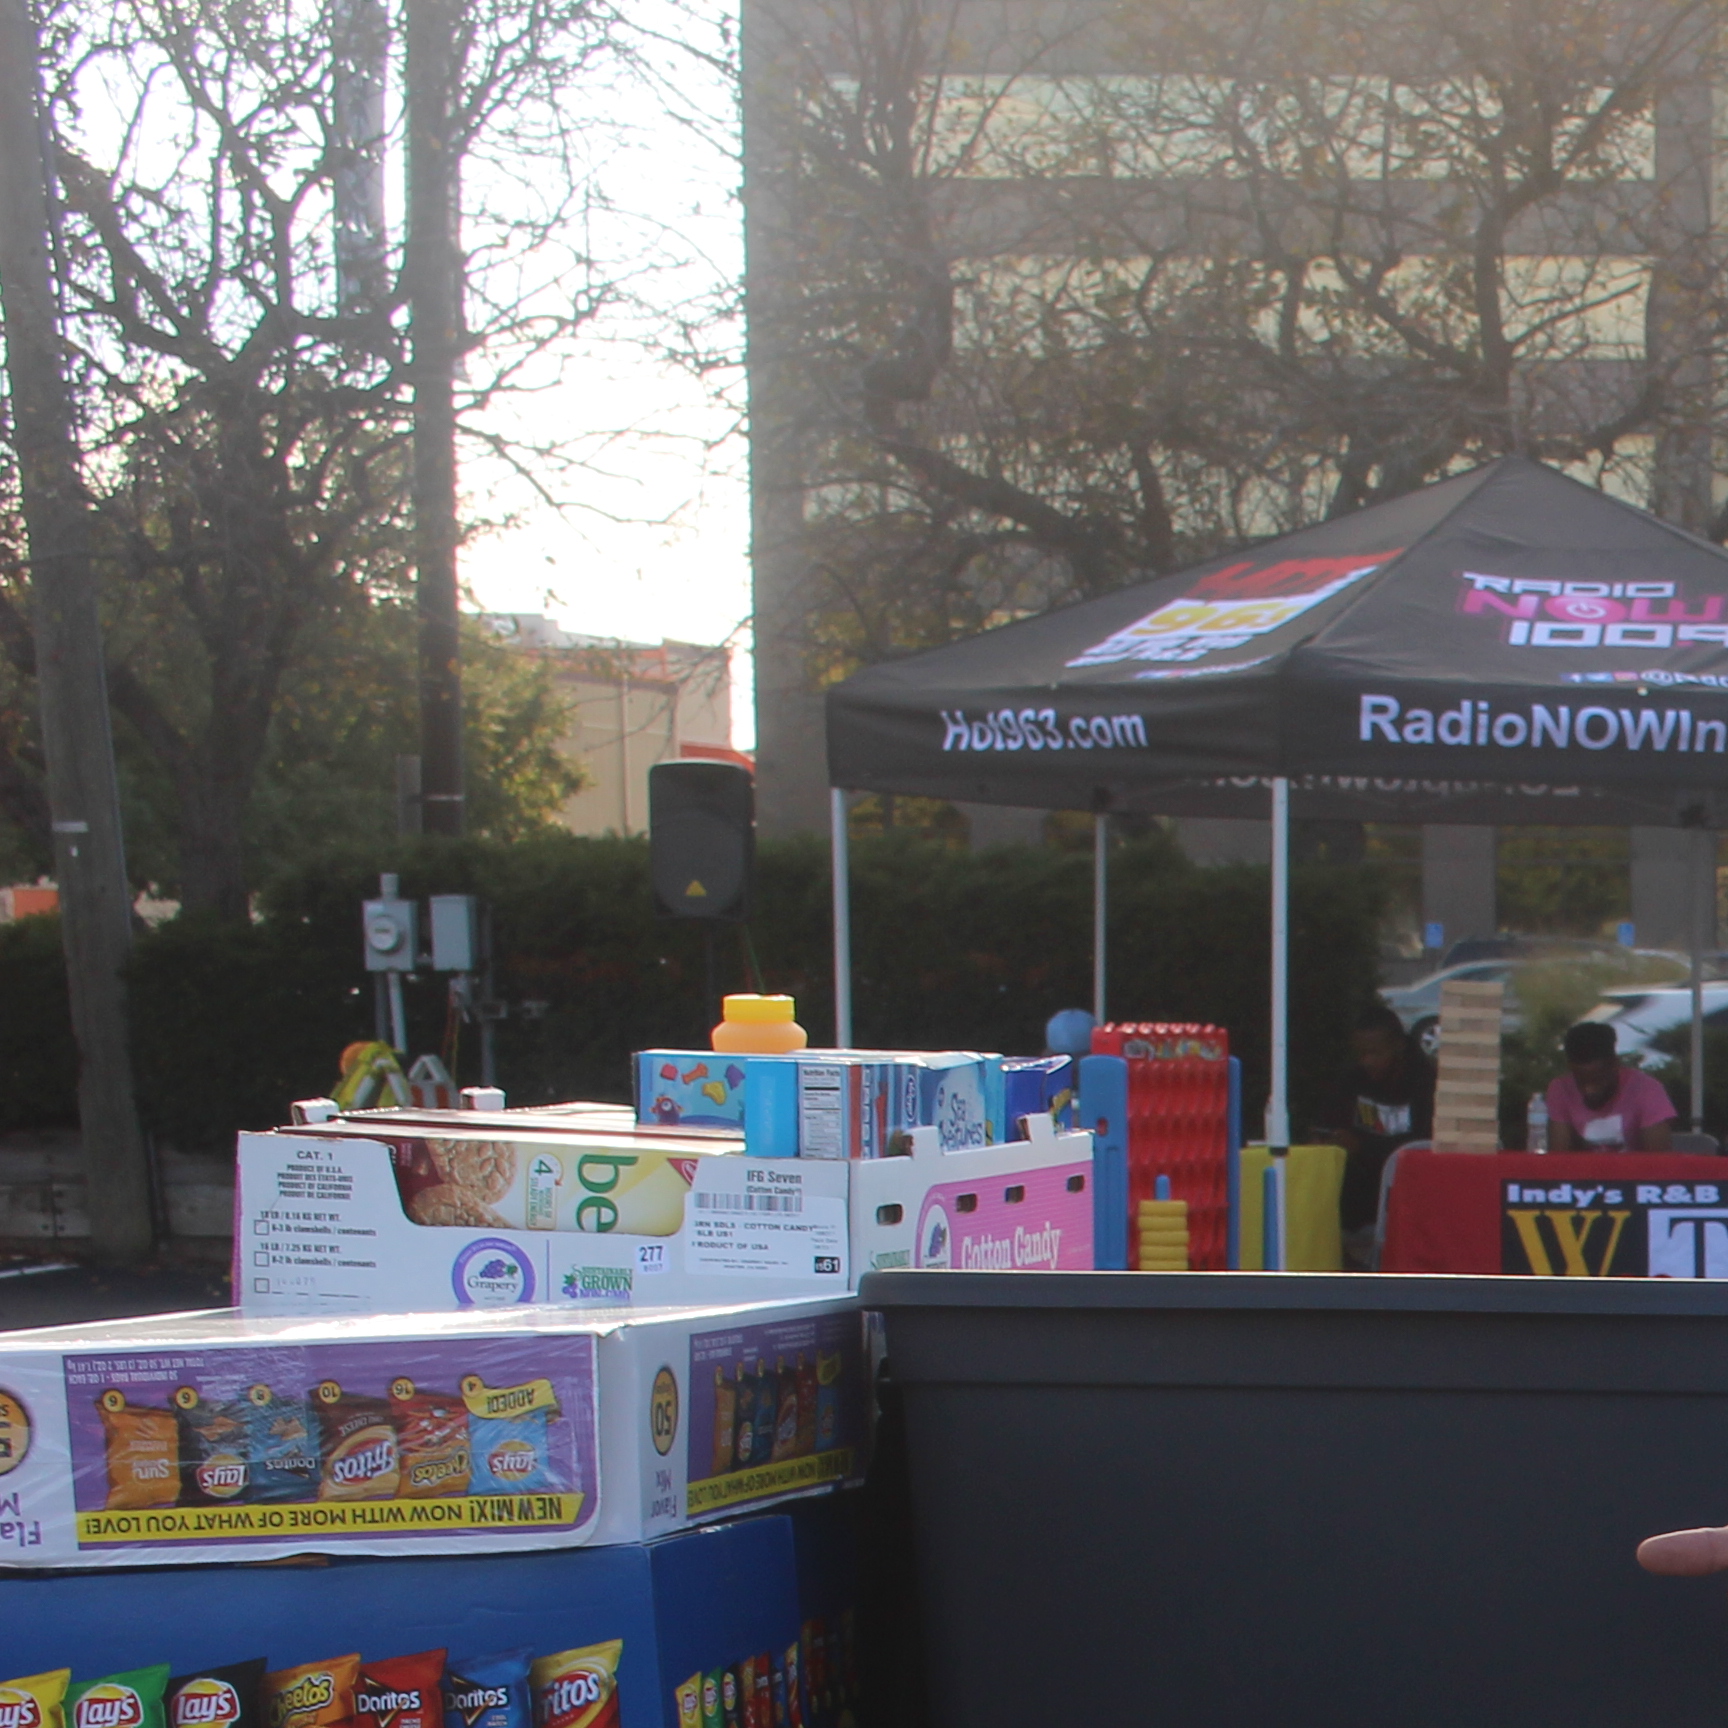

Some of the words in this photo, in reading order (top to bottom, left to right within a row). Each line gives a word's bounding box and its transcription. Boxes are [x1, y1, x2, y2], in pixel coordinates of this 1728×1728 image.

[1462, 571, 1676, 599] RADIO
[940, 708, 1148, 752] Hot963.com
[297, 1150, 323, 1160] CAT.
[327, 1152, 333, 1161] 1
[747, 1169, 765, 1184] IFG
[768, 1170, 802, 1184] Seven
[1507, 1183, 1623, 1209] Indy's
[1637, 1184, 1719, 1205] R&B
[744, 1222, 781, 1231] COTTON
[639, 1245, 663, 1262] 277
[737, 1242, 748, 1250] OF
[750, 1243, 769, 1251] USA
[1014, 1221, 1061, 1270] Candy
[467, 1275, 518, 1293] Grapery
[582, 1275, 633, 1291] GROWN
[486, 1388, 536, 1415] ADDED!
[655, 1401, 672, 1437] 50
[266, 1457, 316, 1472] Doritos
[332, 1426, 399, 1484] Fritos
[492, 1442, 538, 1475] Lay's
[198, 1462, 248, 1493] Lay's
[412, 1453, 471, 1485] Cheetos
[656, 1468, 672, 1491] Mix
[289, 1508, 346, 1527] MORE
[352, 1506, 406, 1526] WITH
[410, 1504, 462, 1525] NOW
[470, 1498, 512, 1524] MIX!
[516, 1496, 562, 1521] NEW
[651, 1495, 677, 1518] Flavor
[85, 1517, 141, 1535] LOVE!
[145, 1515, 189, 1532] YOU
[193, 1512, 254, 1531] WHAT
[256, 1511, 283, 1529] OF
[174, 1688, 235, 1725] Lay's
[270, 1672, 335, 1723] Cheetos
[357, 1691, 421, 1714] Doritos
[445, 1687, 508, 1710] Doritos
